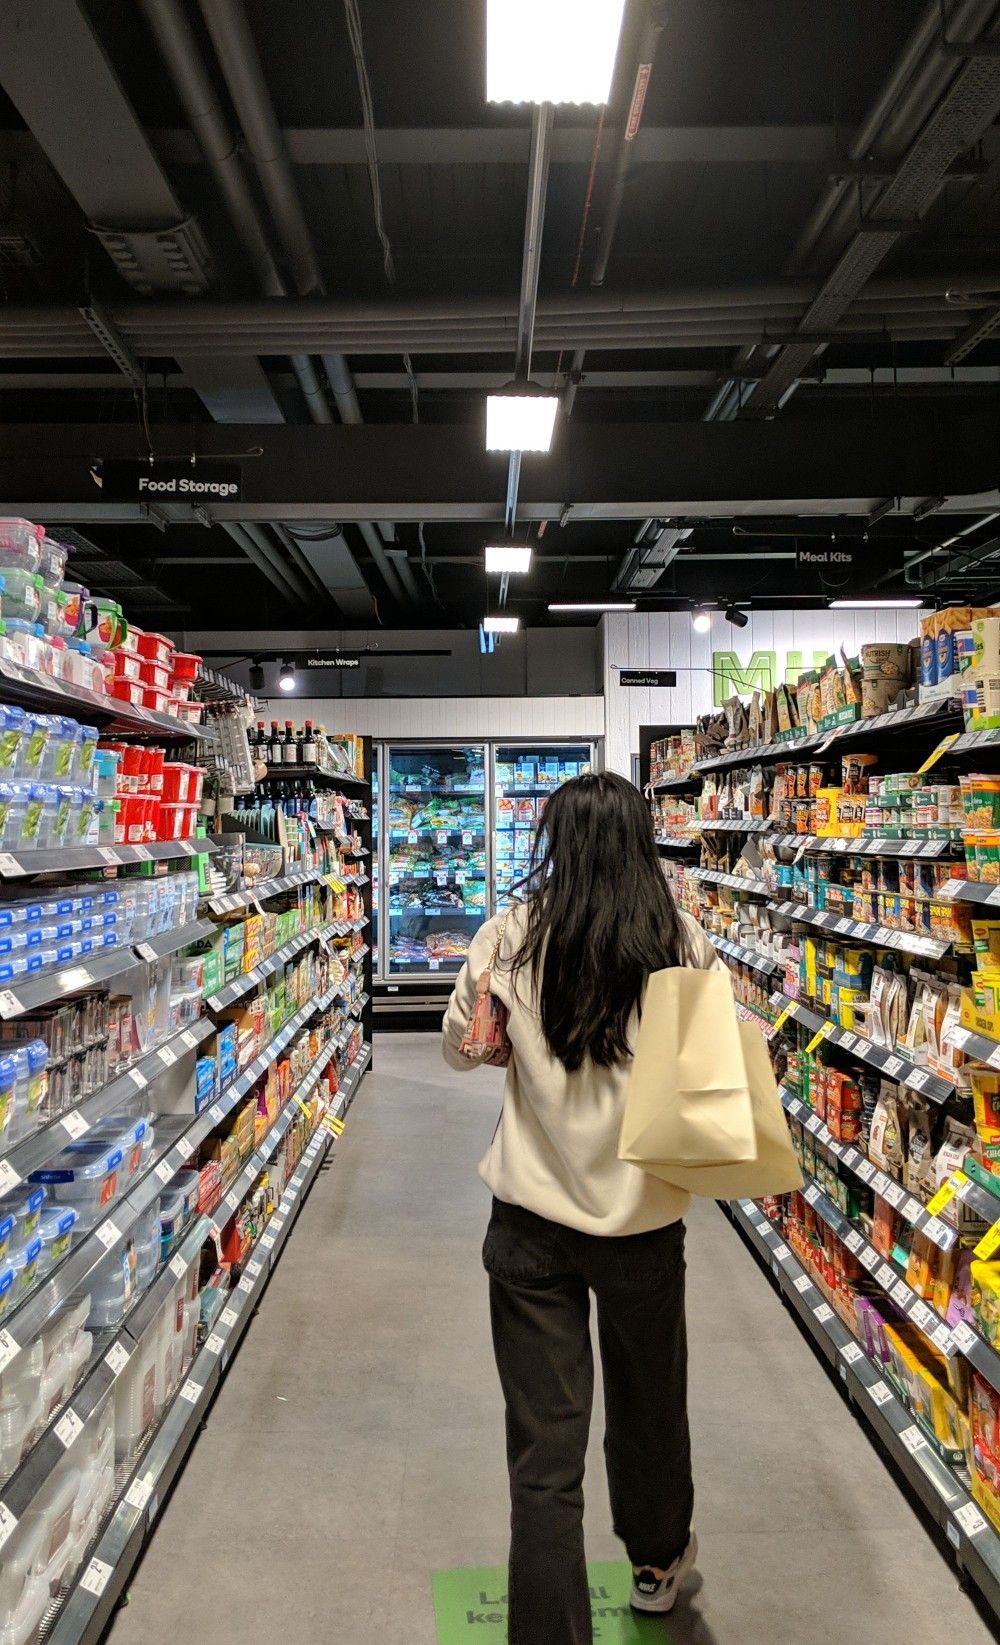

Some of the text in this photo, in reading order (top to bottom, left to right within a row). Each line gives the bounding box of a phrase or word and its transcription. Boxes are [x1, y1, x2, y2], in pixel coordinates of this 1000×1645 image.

[139, 478, 238, 496] Food Storage
[800, 551, 853, 562] Meal Kits
[335, 659, 359, 667] Wraps
[646, 678, 659, 686] Veg
[638, 1582, 657, 1592] NIKE
